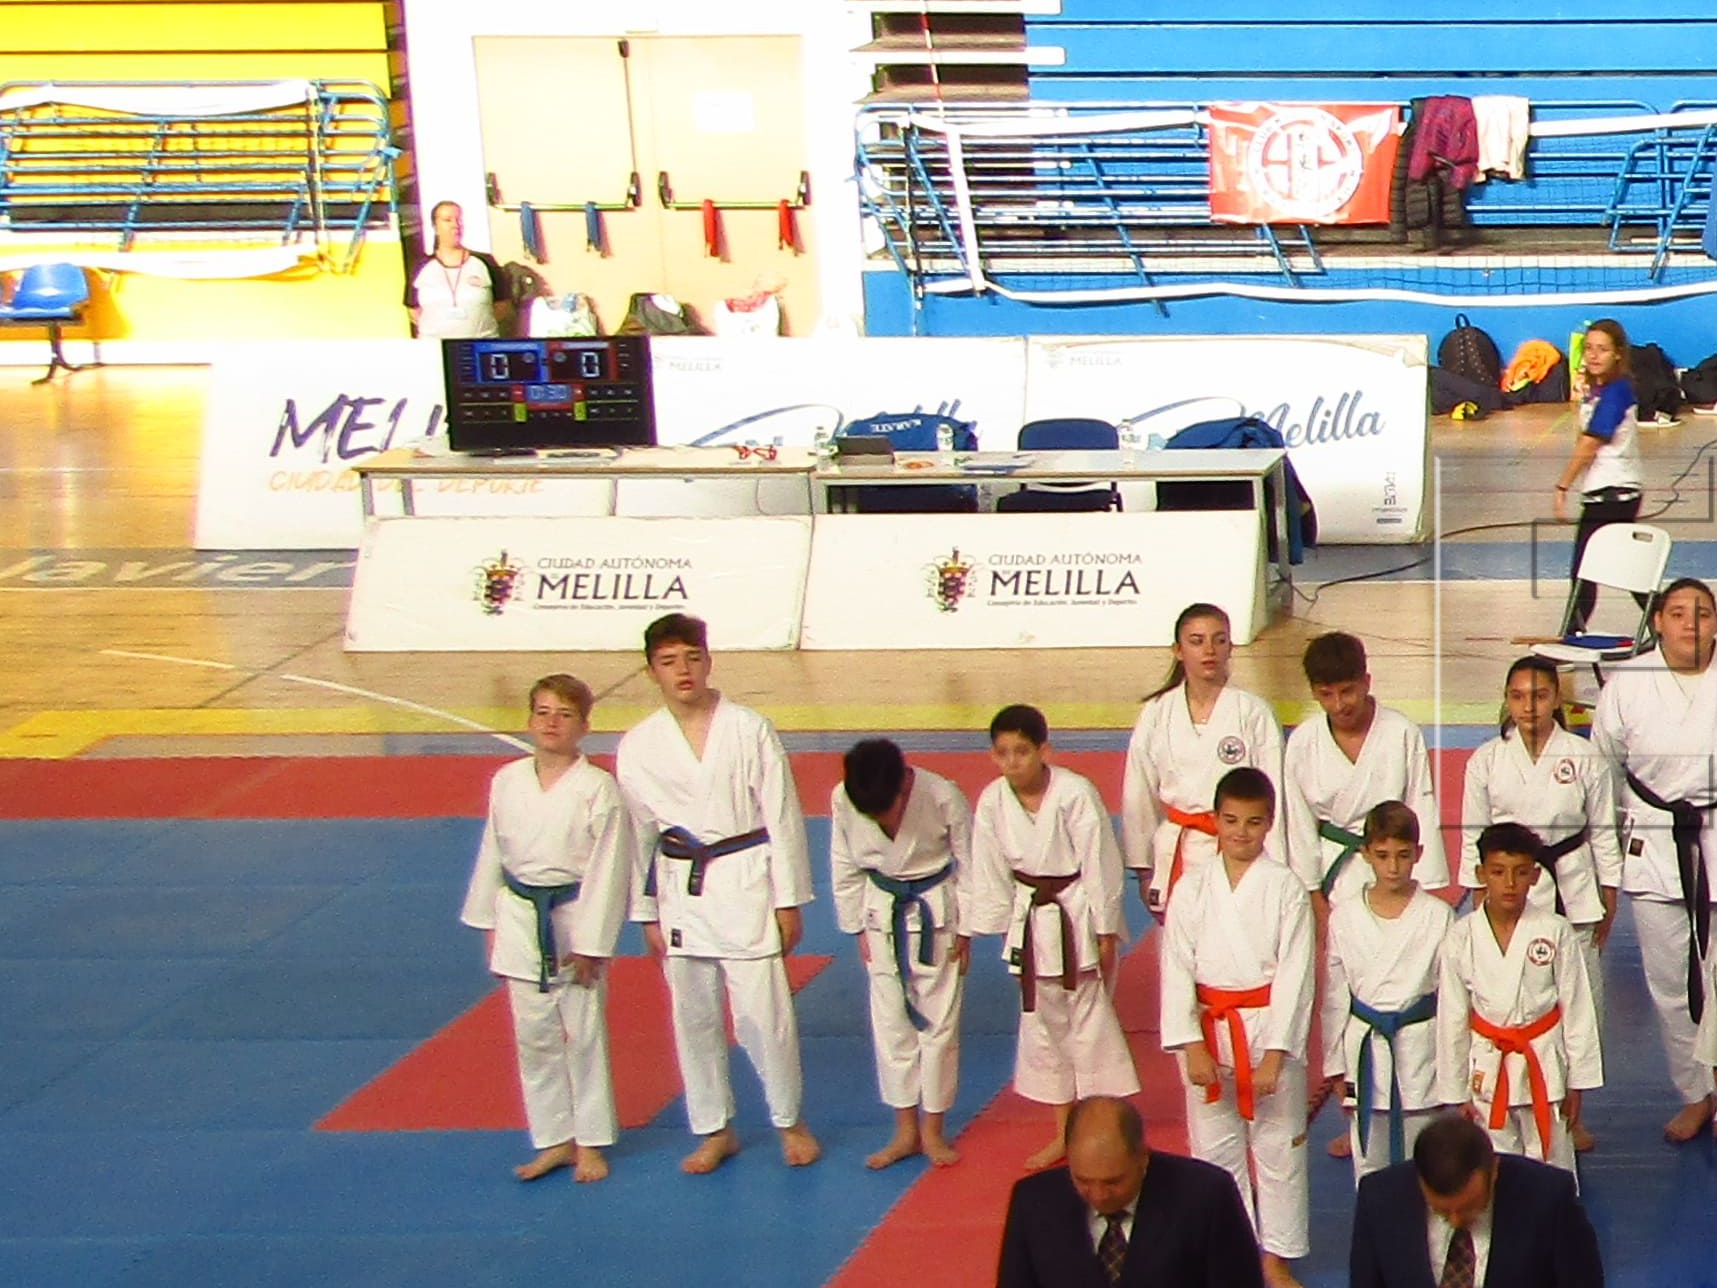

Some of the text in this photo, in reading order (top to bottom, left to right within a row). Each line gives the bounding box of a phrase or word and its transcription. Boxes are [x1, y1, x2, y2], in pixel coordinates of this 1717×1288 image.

[537, 555, 693, 569] CIUDAD AUTÓNOMA
[988, 552, 1143, 566] CIUDAD AUTÓNOMA
[537, 573, 689, 600] MELILLA
[990, 569, 1141, 596] MELILLA
